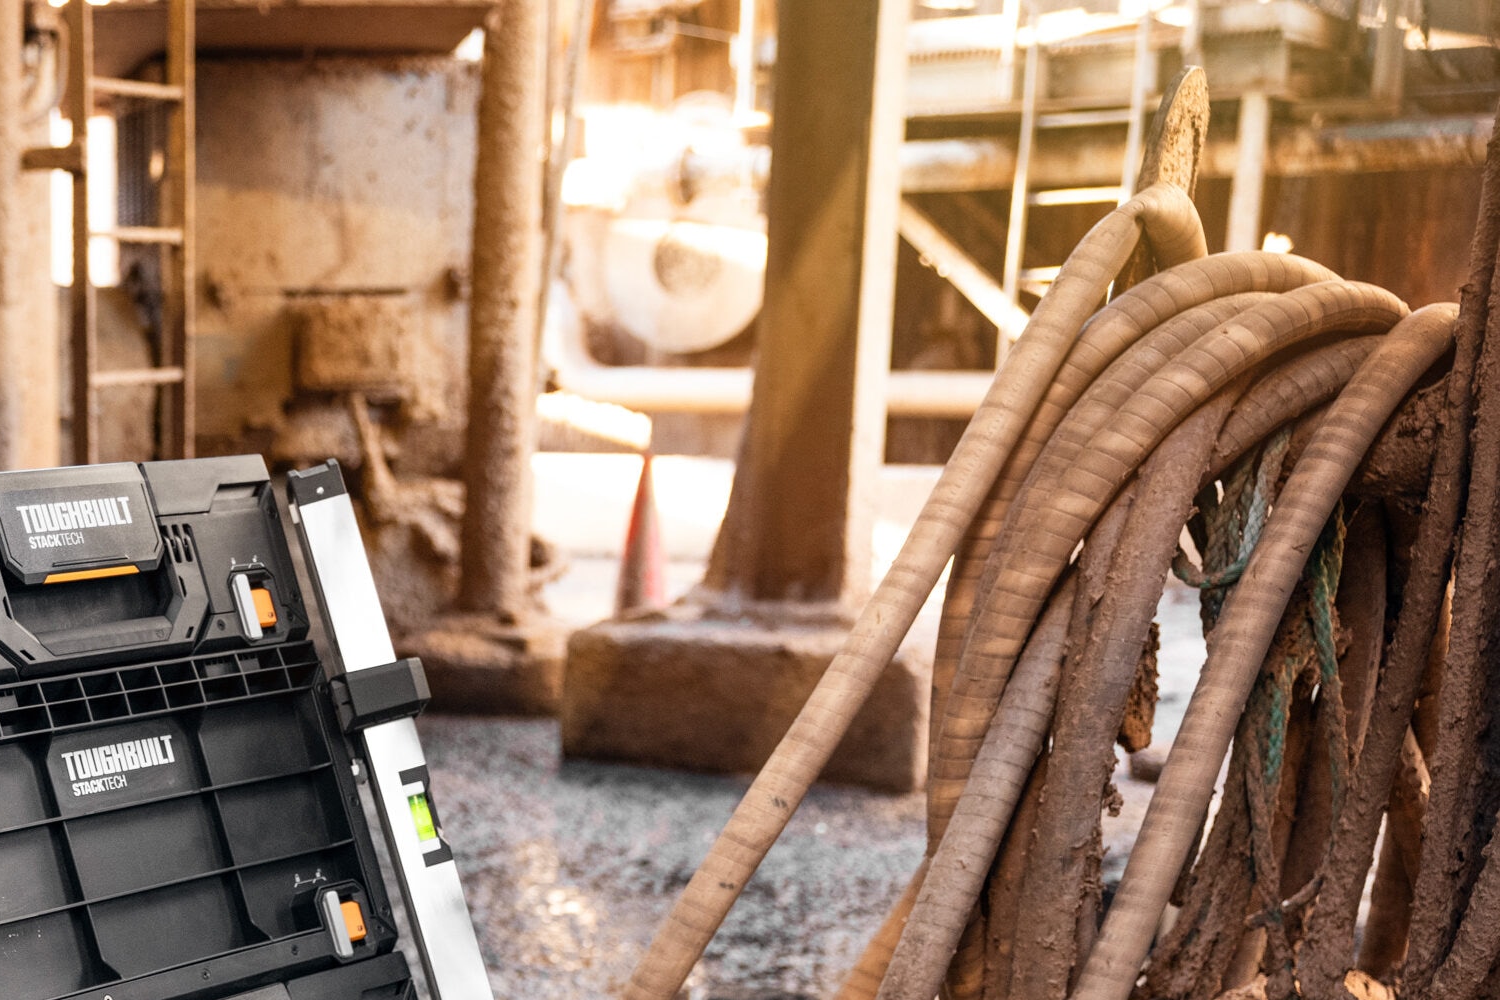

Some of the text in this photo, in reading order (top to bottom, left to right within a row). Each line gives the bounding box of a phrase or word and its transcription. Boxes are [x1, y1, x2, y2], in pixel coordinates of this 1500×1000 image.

[16, 496, 133, 534] TOUGHBUILT
[28, 532, 85, 550] STACKTECH
[61, 734, 176, 782] TOUGHBUILT
[72, 774, 128, 797] STACKTECH
